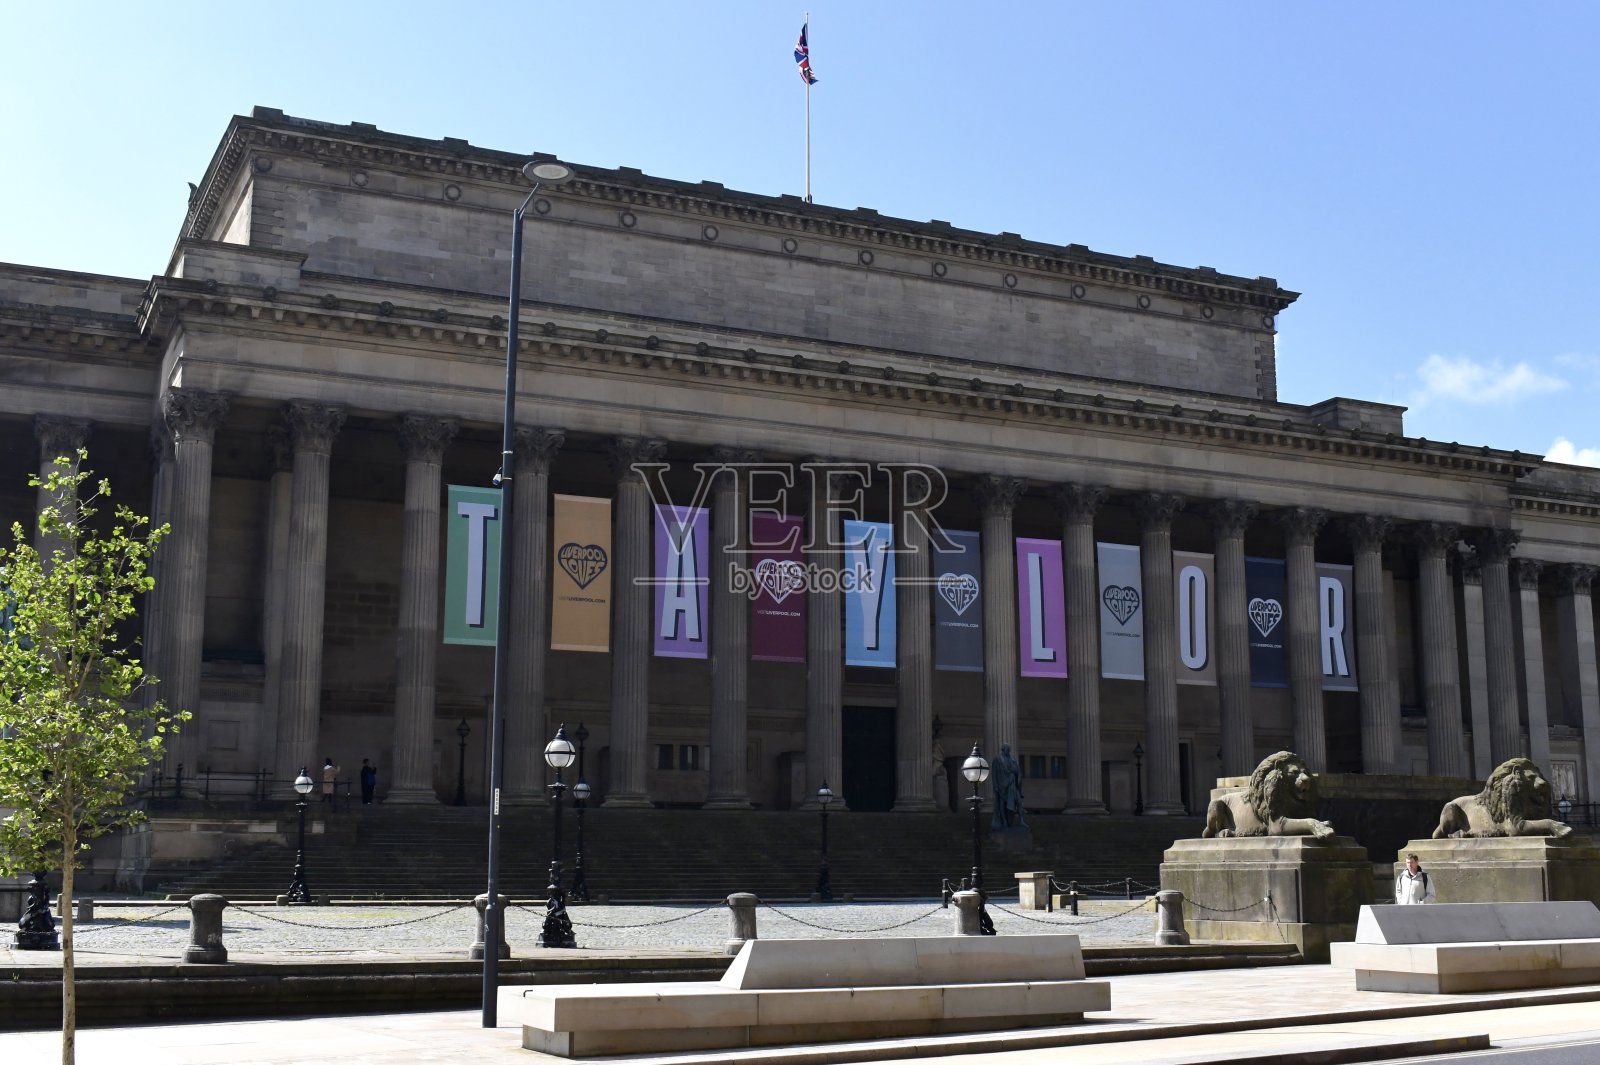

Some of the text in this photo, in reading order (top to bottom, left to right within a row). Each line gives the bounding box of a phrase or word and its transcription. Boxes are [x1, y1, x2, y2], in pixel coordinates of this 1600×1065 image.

[457, 502, 497, 627] T
[560, 546, 607, 562] LIVERPOOL
[560, 558, 606, 586] LOVES
[661, 521, 701, 641] A
[850, 536, 889, 650] Y
[940, 587, 978, 612] LOVES
[1104, 588, 1139, 602] LIVERPOOL
[1028, 553, 1056, 662] L
[1105, 599, 1139, 622] LOVES
[1180, 565, 1207, 670] O
[1250, 601, 1281, 614] LIVERPOOL
[1250, 611, 1281, 635] LOVES
[1319, 577, 1349, 677] R
